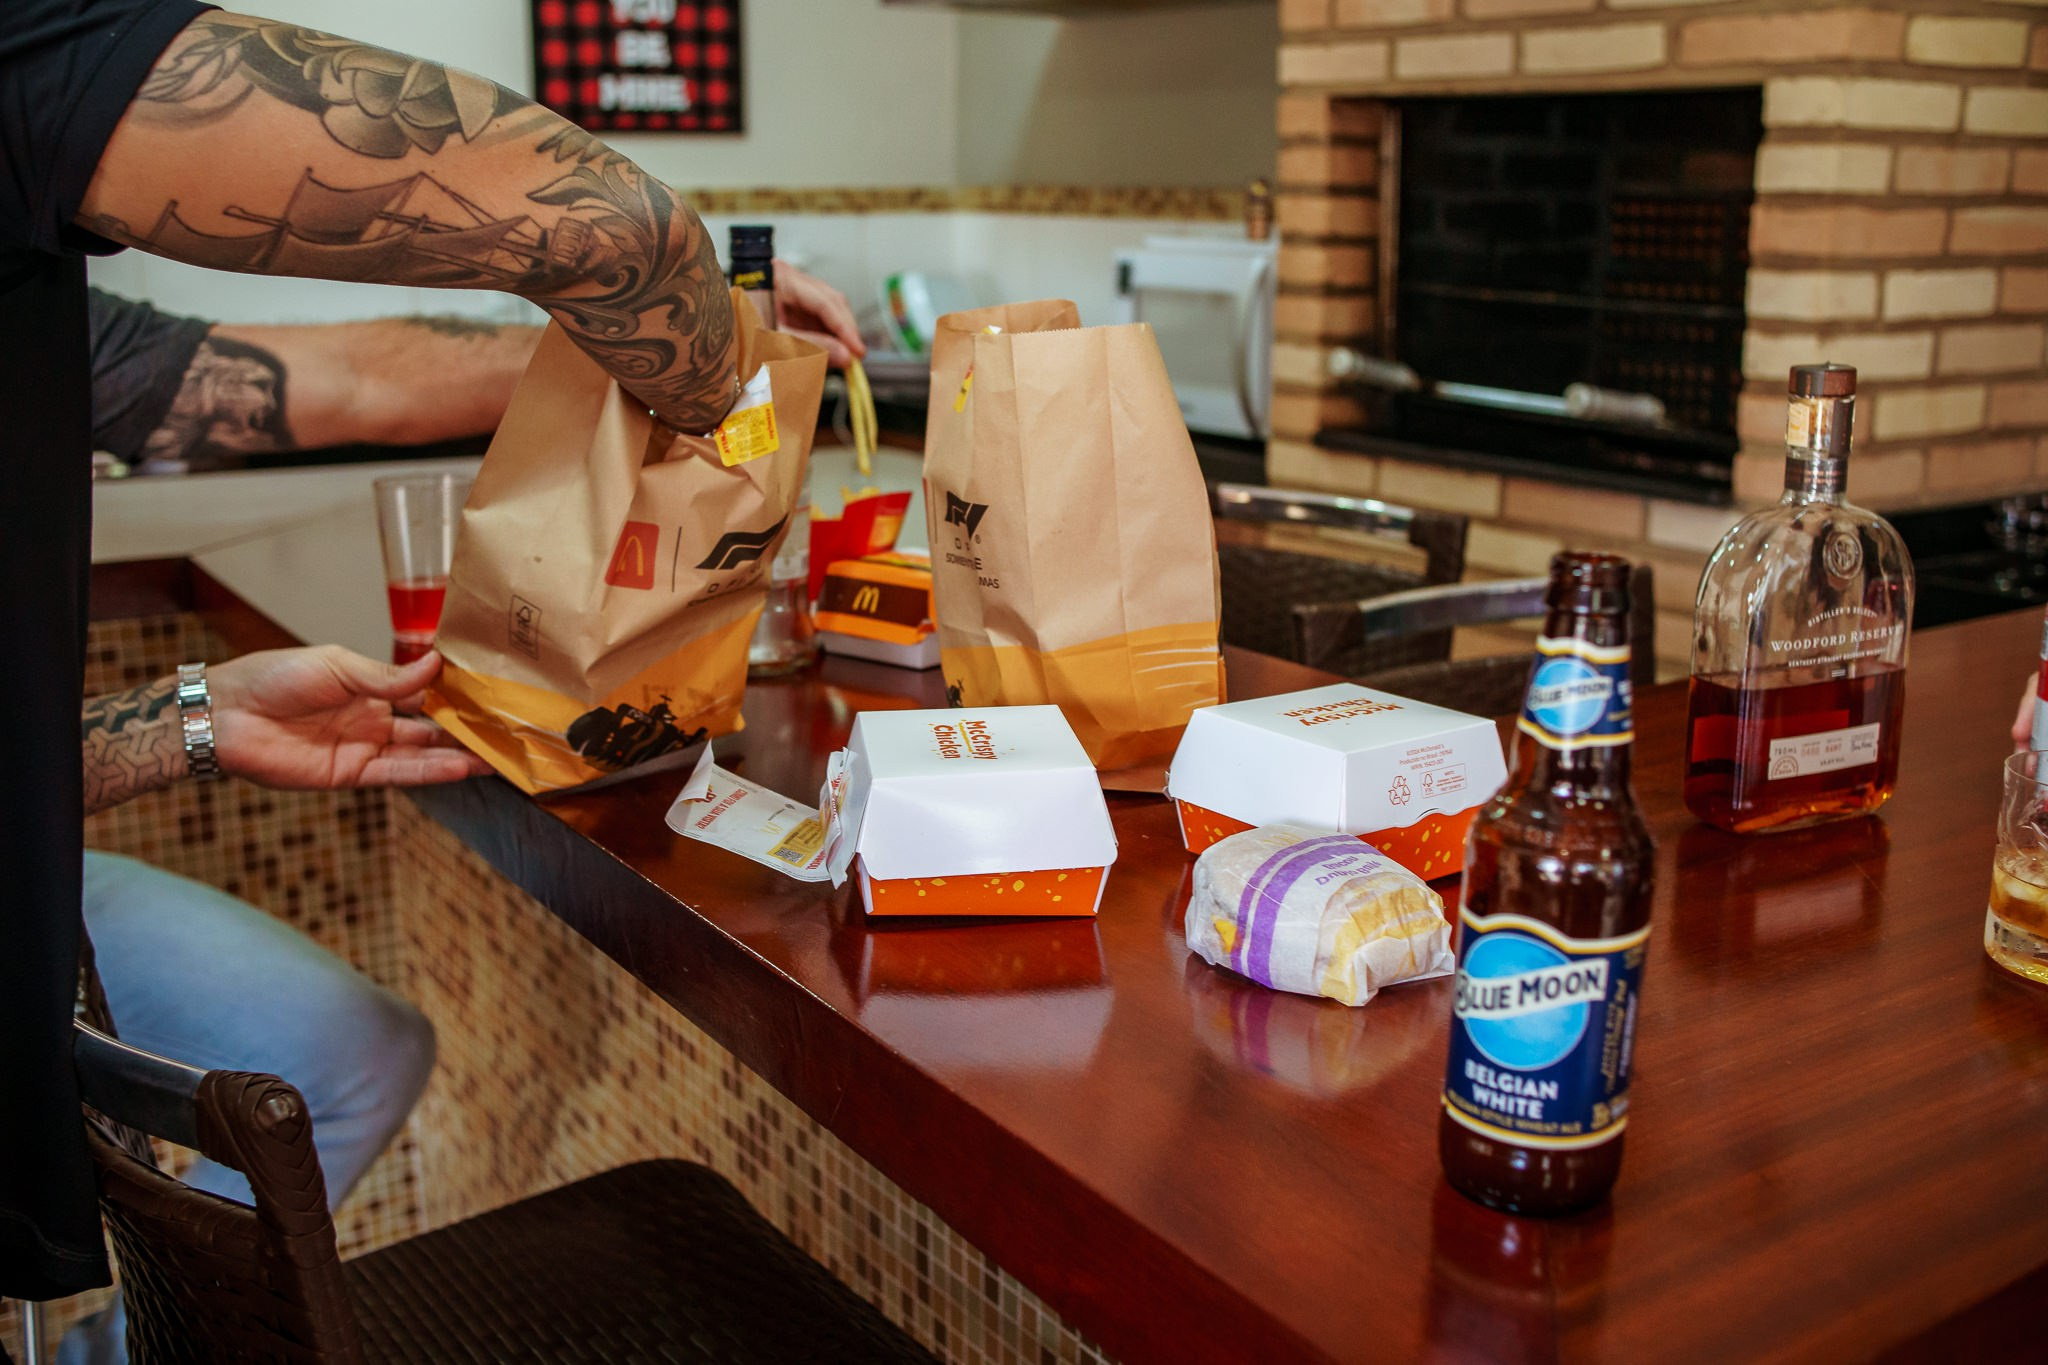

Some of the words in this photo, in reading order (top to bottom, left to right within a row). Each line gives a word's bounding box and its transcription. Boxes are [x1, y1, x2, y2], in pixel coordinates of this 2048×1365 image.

[616, 30, 671, 67] BE
[598, 73, 691, 112] MINE
[1771, 634, 1846, 652] WOODFORD
[1283, 698, 1374, 718] Chicken
[1299, 703, 1405, 727] McCrispy
[933, 724, 963, 759] Chicken
[965, 720, 999, 760] McCrispy
[1455, 972, 1512, 1013] BLUE
[1518, 966, 1603, 1007] MOON
[1464, 1058, 1559, 1101] BELGIAN
[1471, 1082, 1545, 1120] WHITE
